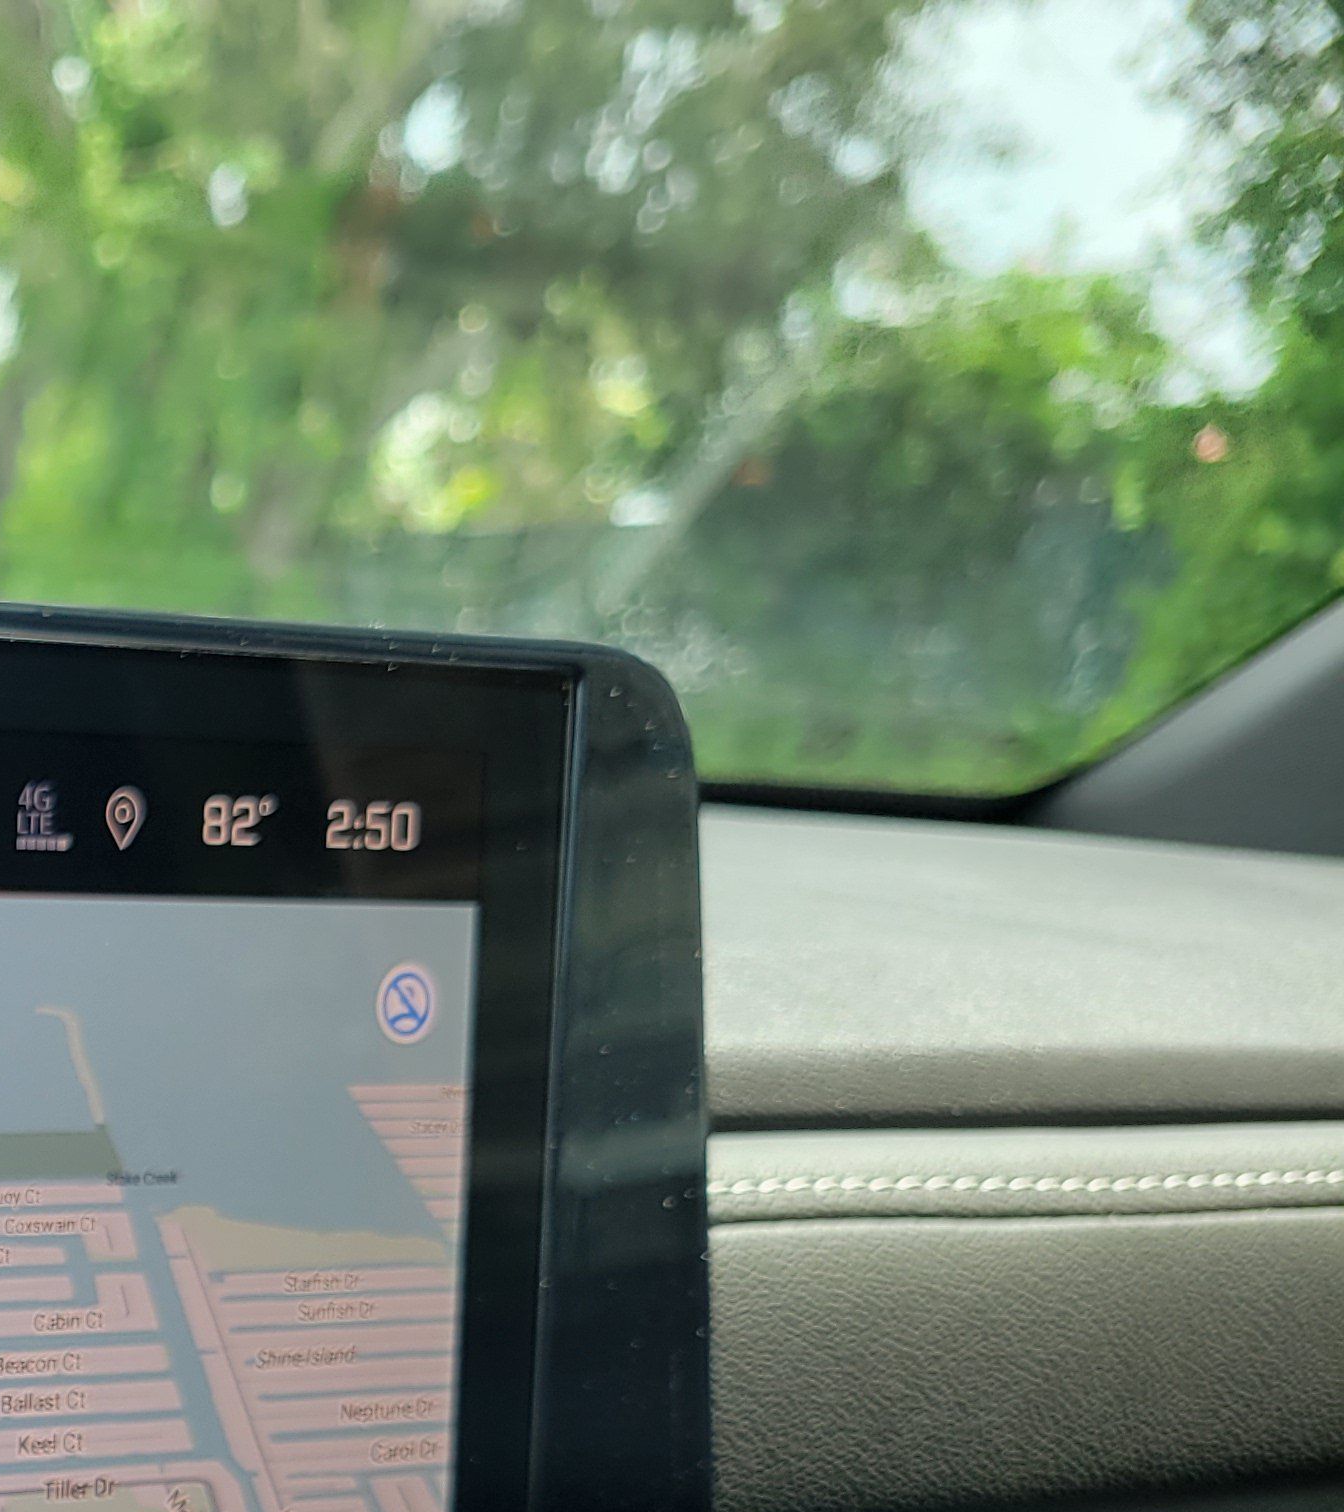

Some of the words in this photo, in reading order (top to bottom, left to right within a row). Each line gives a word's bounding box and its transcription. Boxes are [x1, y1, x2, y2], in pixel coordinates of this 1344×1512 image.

[18, 780, 54, 811] 4G
[17, 811, 55, 835] LTE
[326, 799, 421, 851] 2:50
[25, 1189, 41, 1204] Ct
[80, 1217, 96, 1232] Ct
[34, 1313, 81, 1331] Cabin
[86, 1312, 103, 1328] Ct
[63, 1354, 81, 1371] Ct
[1, 1394, 61, 1413] Ballast
[67, 1392, 85, 1409] Ct
[18, 1436, 56, 1455] Keel
[63, 1434, 82, 1452] Ct
[95, 1479, 114, 1497] Dr
